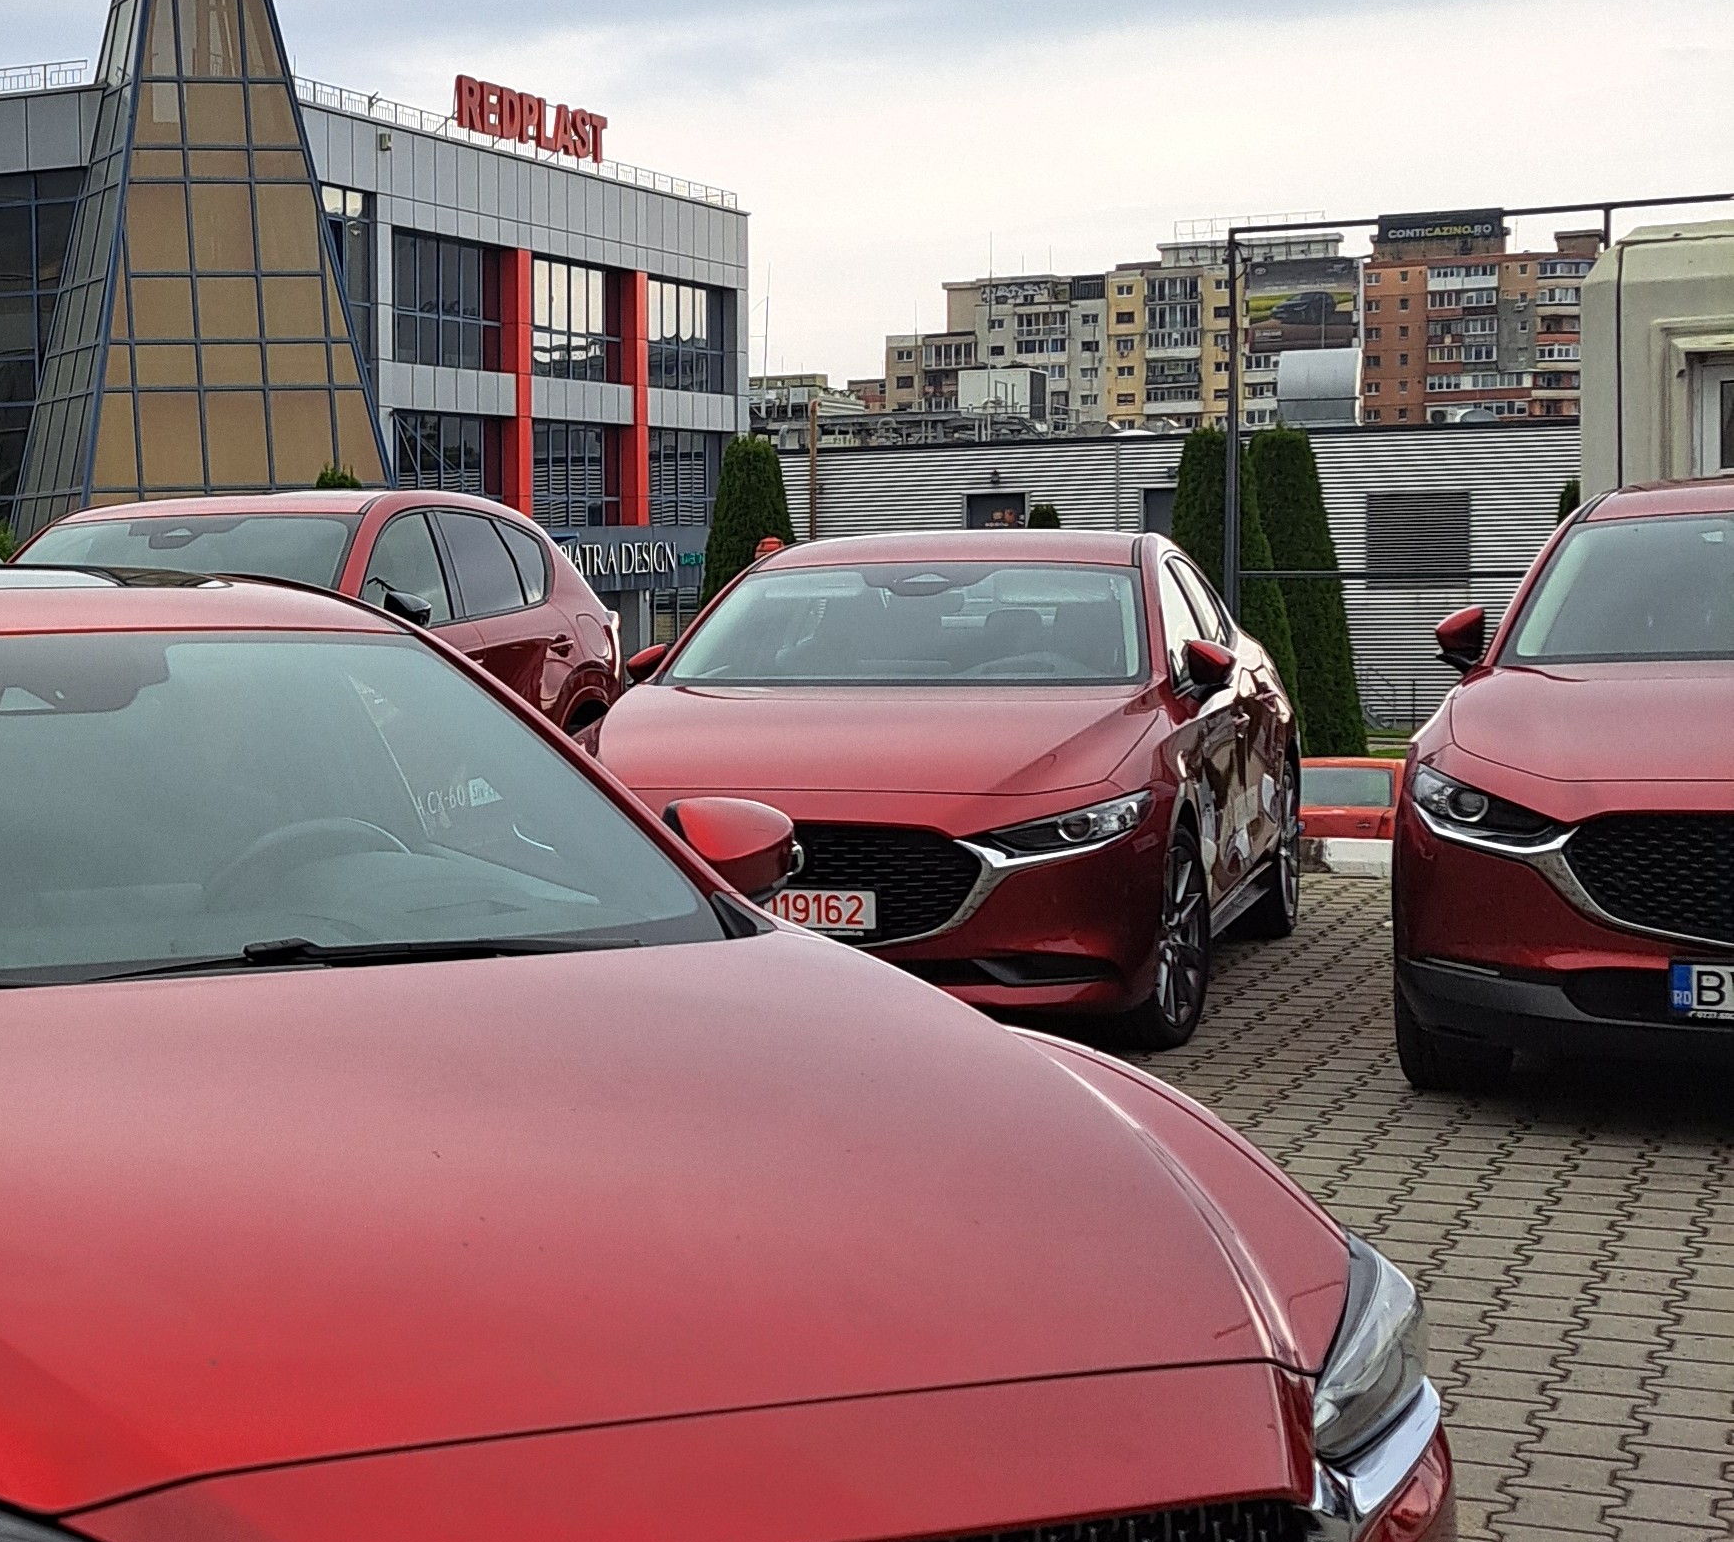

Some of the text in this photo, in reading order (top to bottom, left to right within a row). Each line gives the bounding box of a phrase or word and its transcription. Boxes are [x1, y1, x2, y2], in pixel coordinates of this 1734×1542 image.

[455, 74, 608, 164] REDPLAST
[1388, 224, 1493, 239] CONTICAZINO.RO
[621, 541, 677, 574] DESIGN
[1697, 970, 1734, 1006] B
